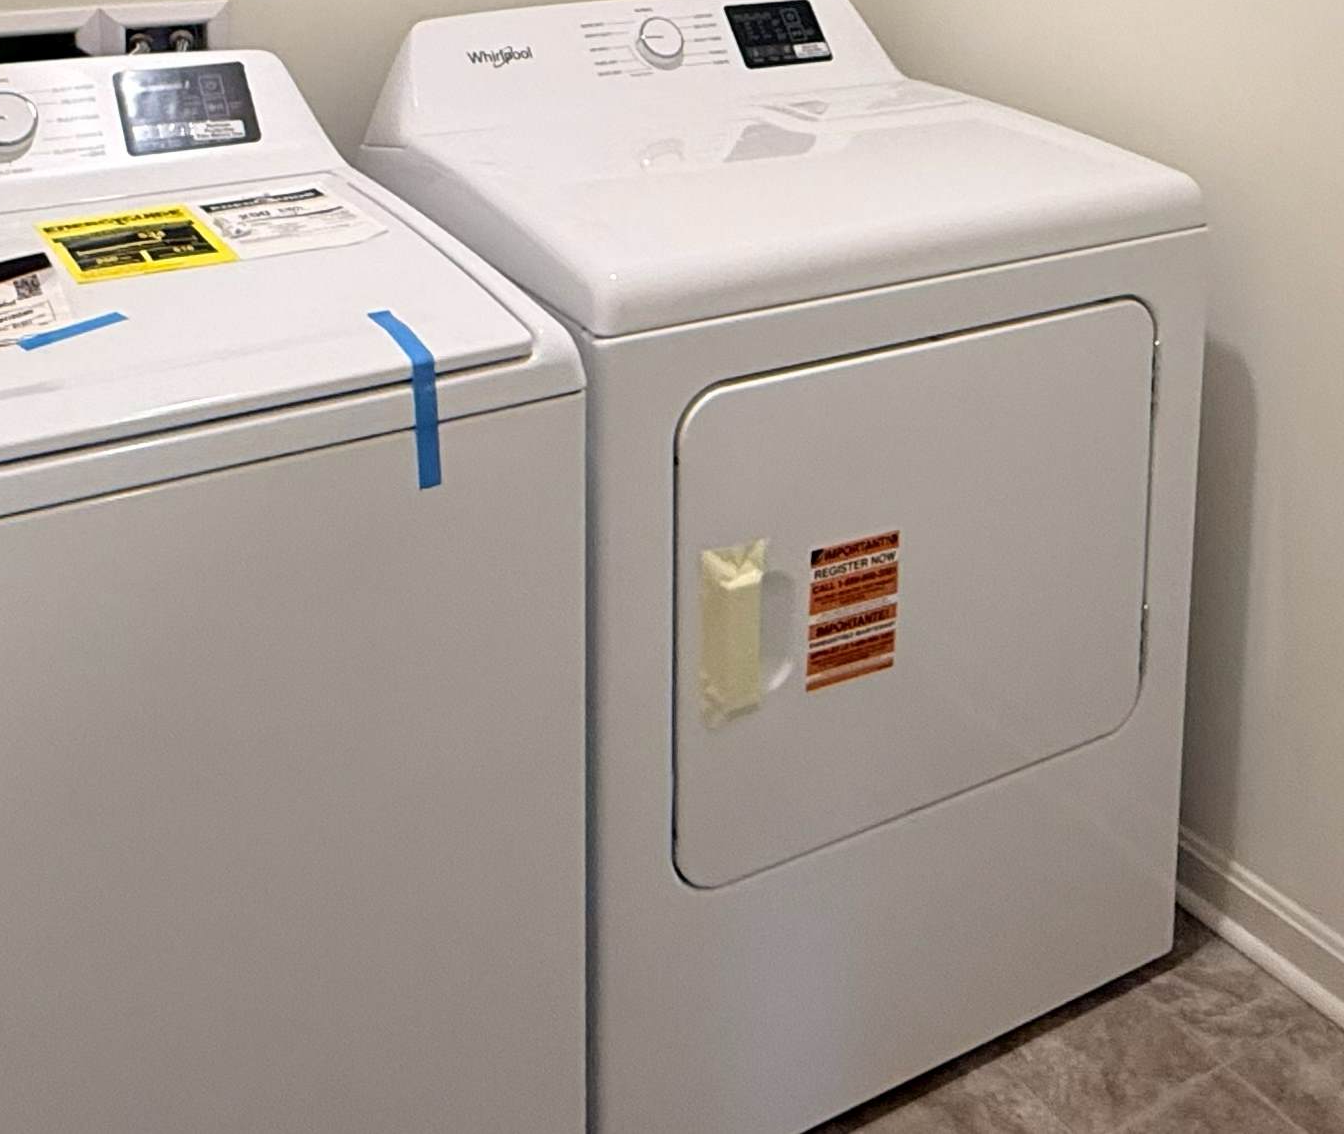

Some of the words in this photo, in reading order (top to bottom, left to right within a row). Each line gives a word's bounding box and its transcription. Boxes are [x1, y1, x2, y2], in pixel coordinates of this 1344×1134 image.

[466, 45, 533, 68] Whirlpool
[814, 557, 869, 579] REGISTER
[870, 550, 896, 564] NOW
